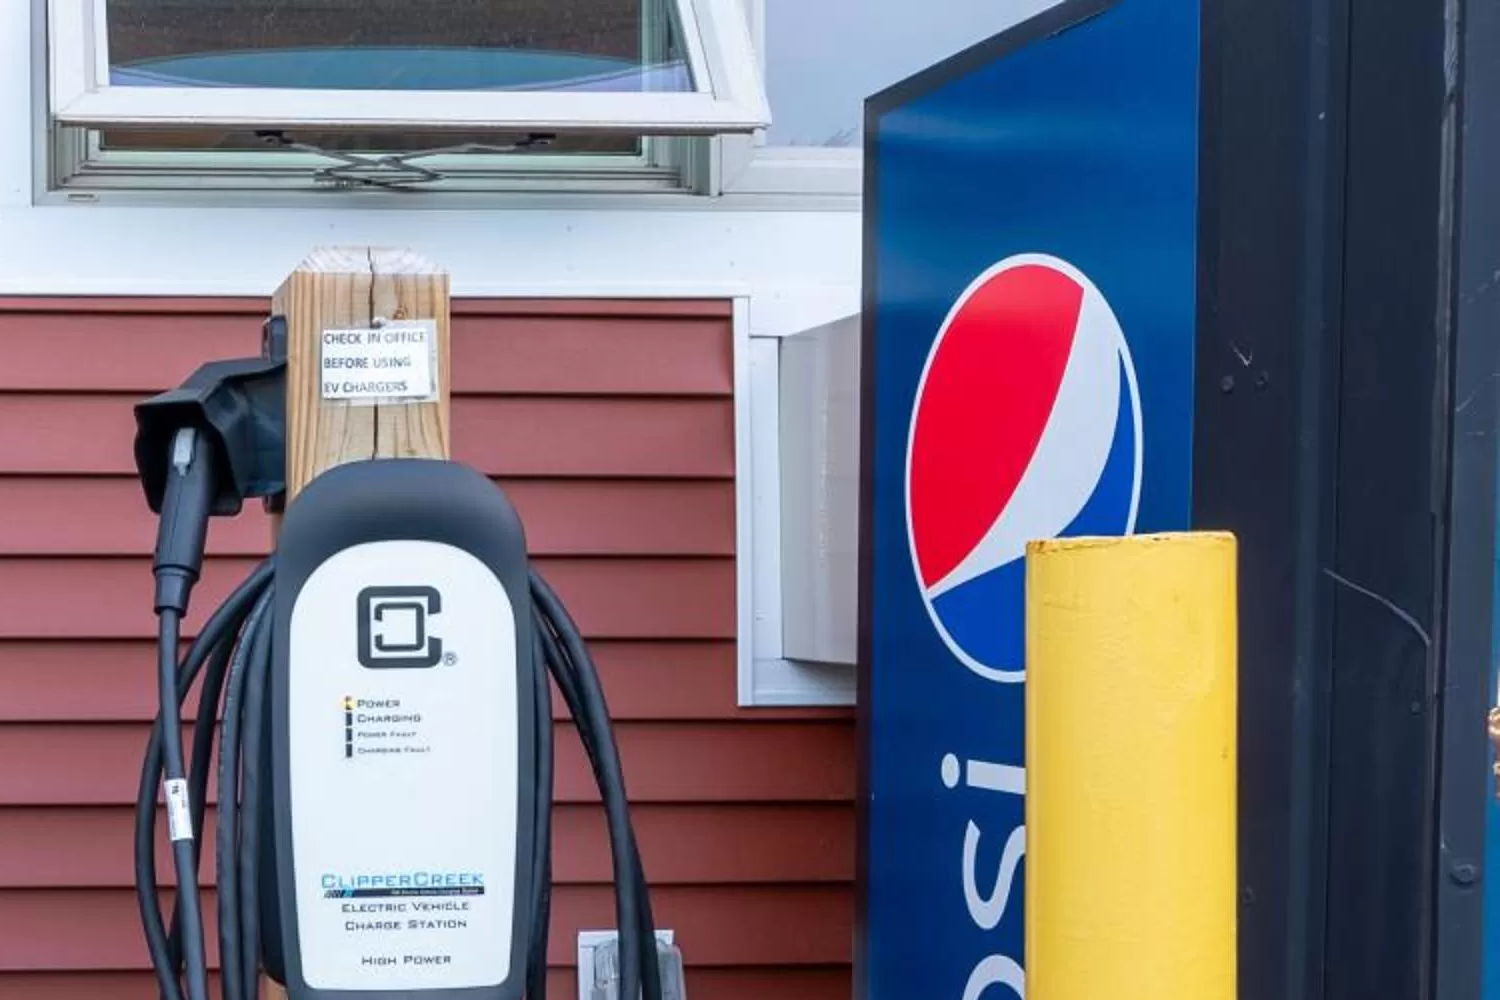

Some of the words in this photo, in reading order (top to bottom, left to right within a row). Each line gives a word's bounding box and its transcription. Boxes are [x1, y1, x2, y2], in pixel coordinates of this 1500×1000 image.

[323, 333, 362, 344] CHECK
[367, 333, 380, 344] IN
[384, 331, 424, 343] OFFICE
[323, 357, 368, 369] BEFORE
[373, 356, 411, 368] USING
[324, 383, 338, 393] EV
[342, 381, 408, 393] CHARGERS
[356, 699, 400, 708] POWER
[357, 714, 421, 723] CHARGING
[341, 903, 406, 913] ELECTRIC
[412, 901, 469, 911] VEHICLE
[344, 921, 400, 931] CHARGE
[408, 919, 467, 929] STATION
[361, 957, 397, 966] HIGH
[403, 955, 451, 965] POWER
